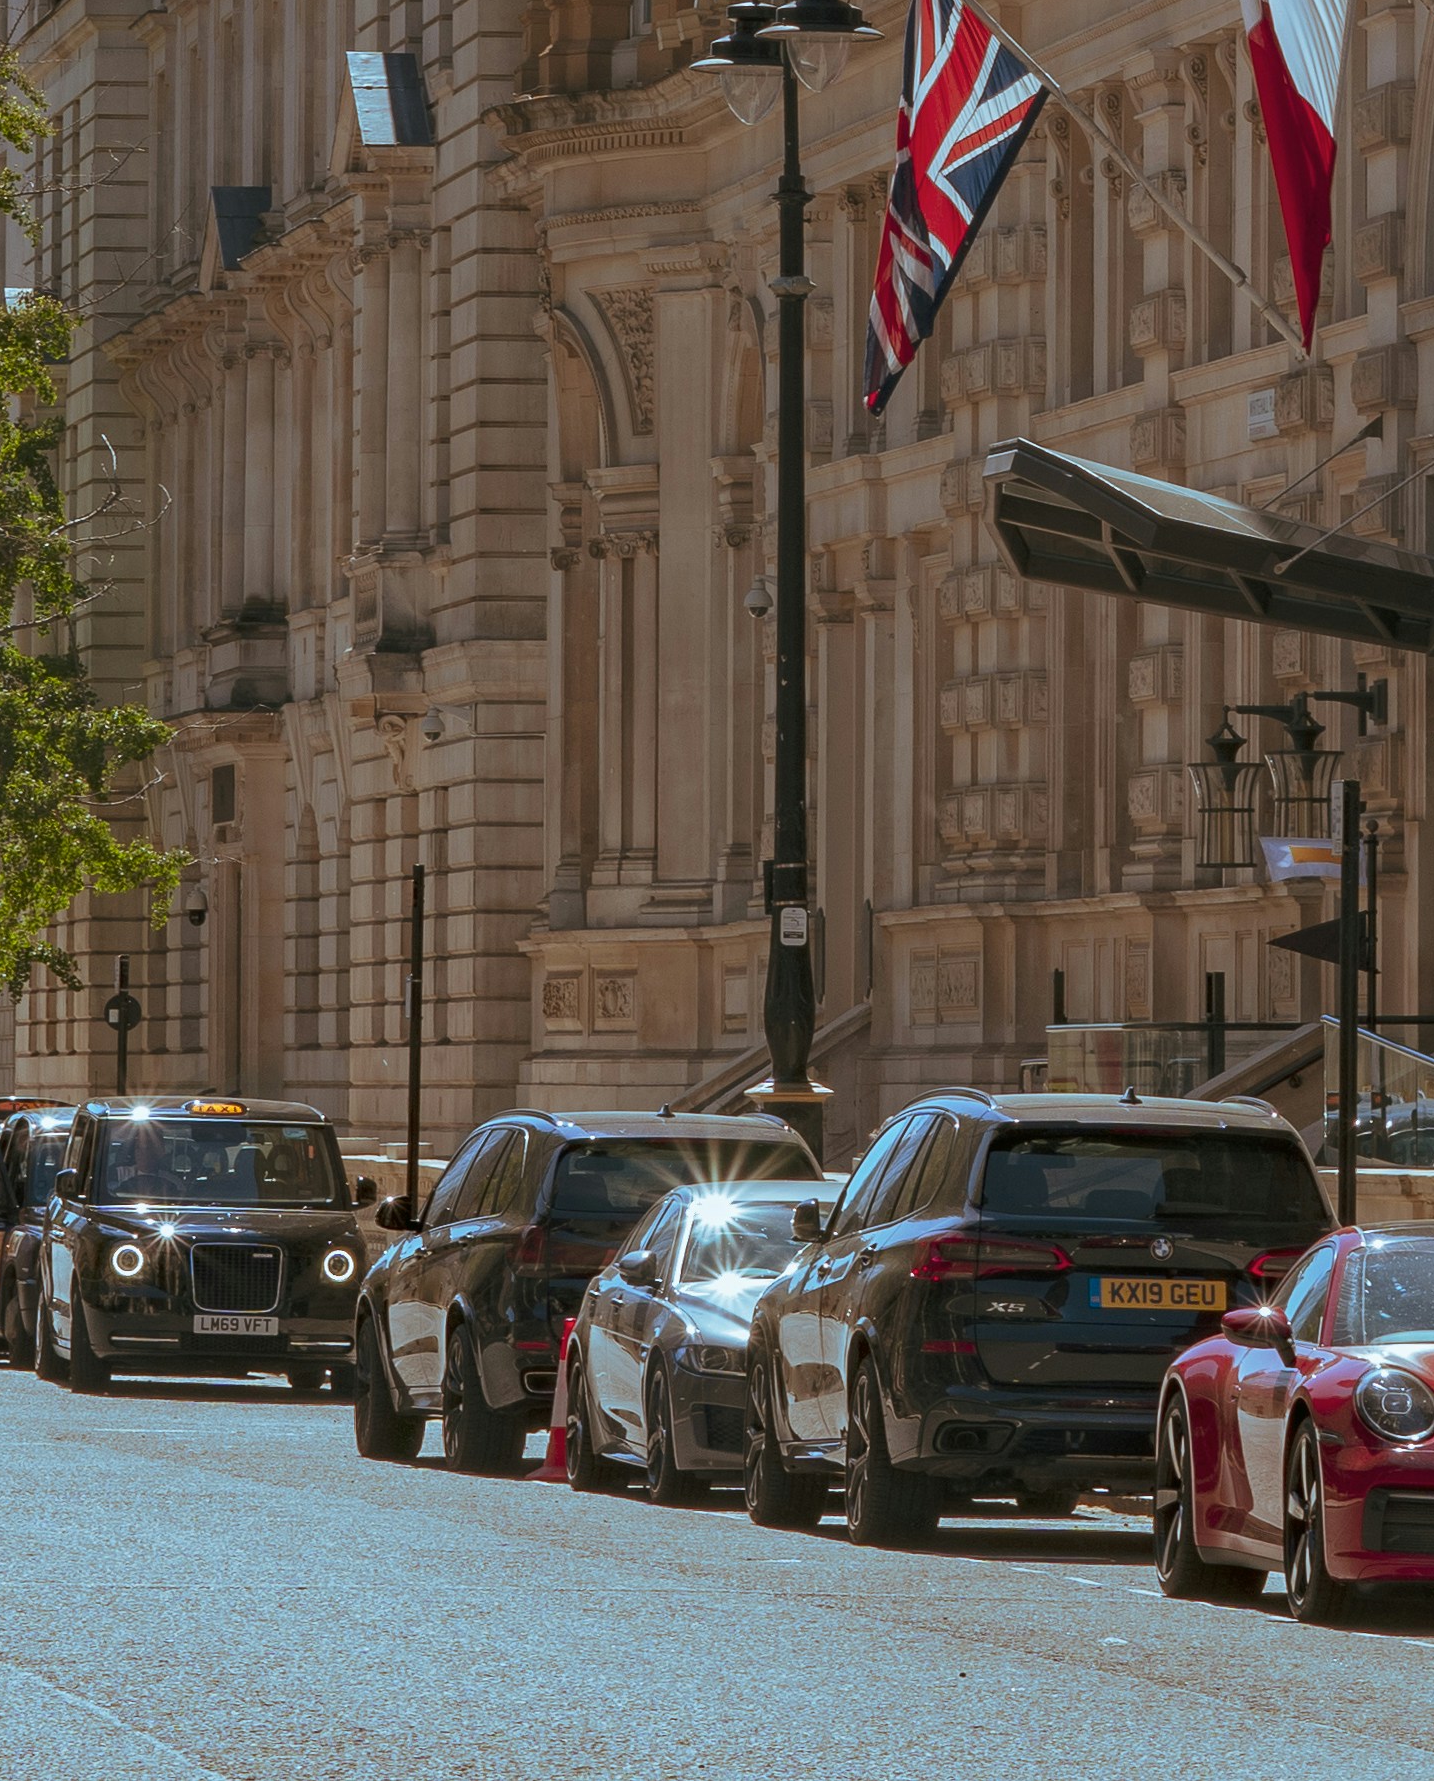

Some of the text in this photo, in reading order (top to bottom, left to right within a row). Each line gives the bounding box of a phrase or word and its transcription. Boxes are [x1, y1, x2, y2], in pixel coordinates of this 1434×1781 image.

[196, 1105, 238, 1113] TAXI
[1110, 1281, 1216, 1305] KX19 GEU
[986, 1302, 1027, 1313] X5
[200, 1317, 272, 1333] LM69 VFT
